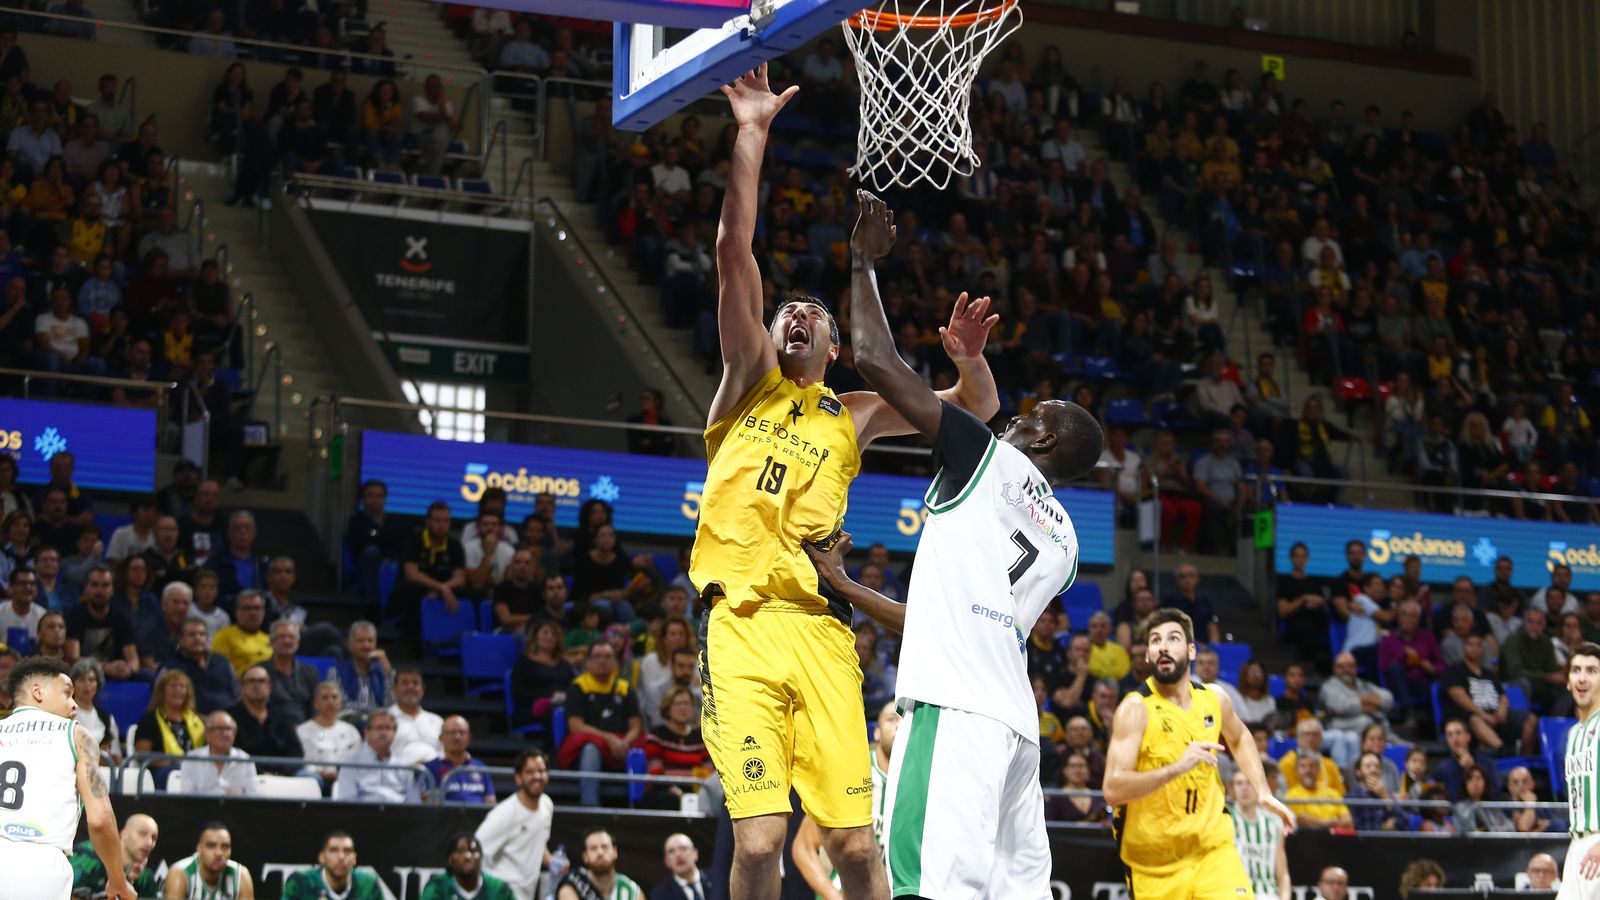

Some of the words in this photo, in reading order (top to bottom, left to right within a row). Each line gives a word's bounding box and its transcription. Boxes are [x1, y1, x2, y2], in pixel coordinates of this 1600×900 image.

[375, 273, 456, 294] TENERIFE
[453, 350, 498, 375] EXIT
[756, 455, 787, 495] 19
[0, 760, 26, 810] 8
[1185, 789, 1198, 814] 11
[8, 825, 36, 837] plus
